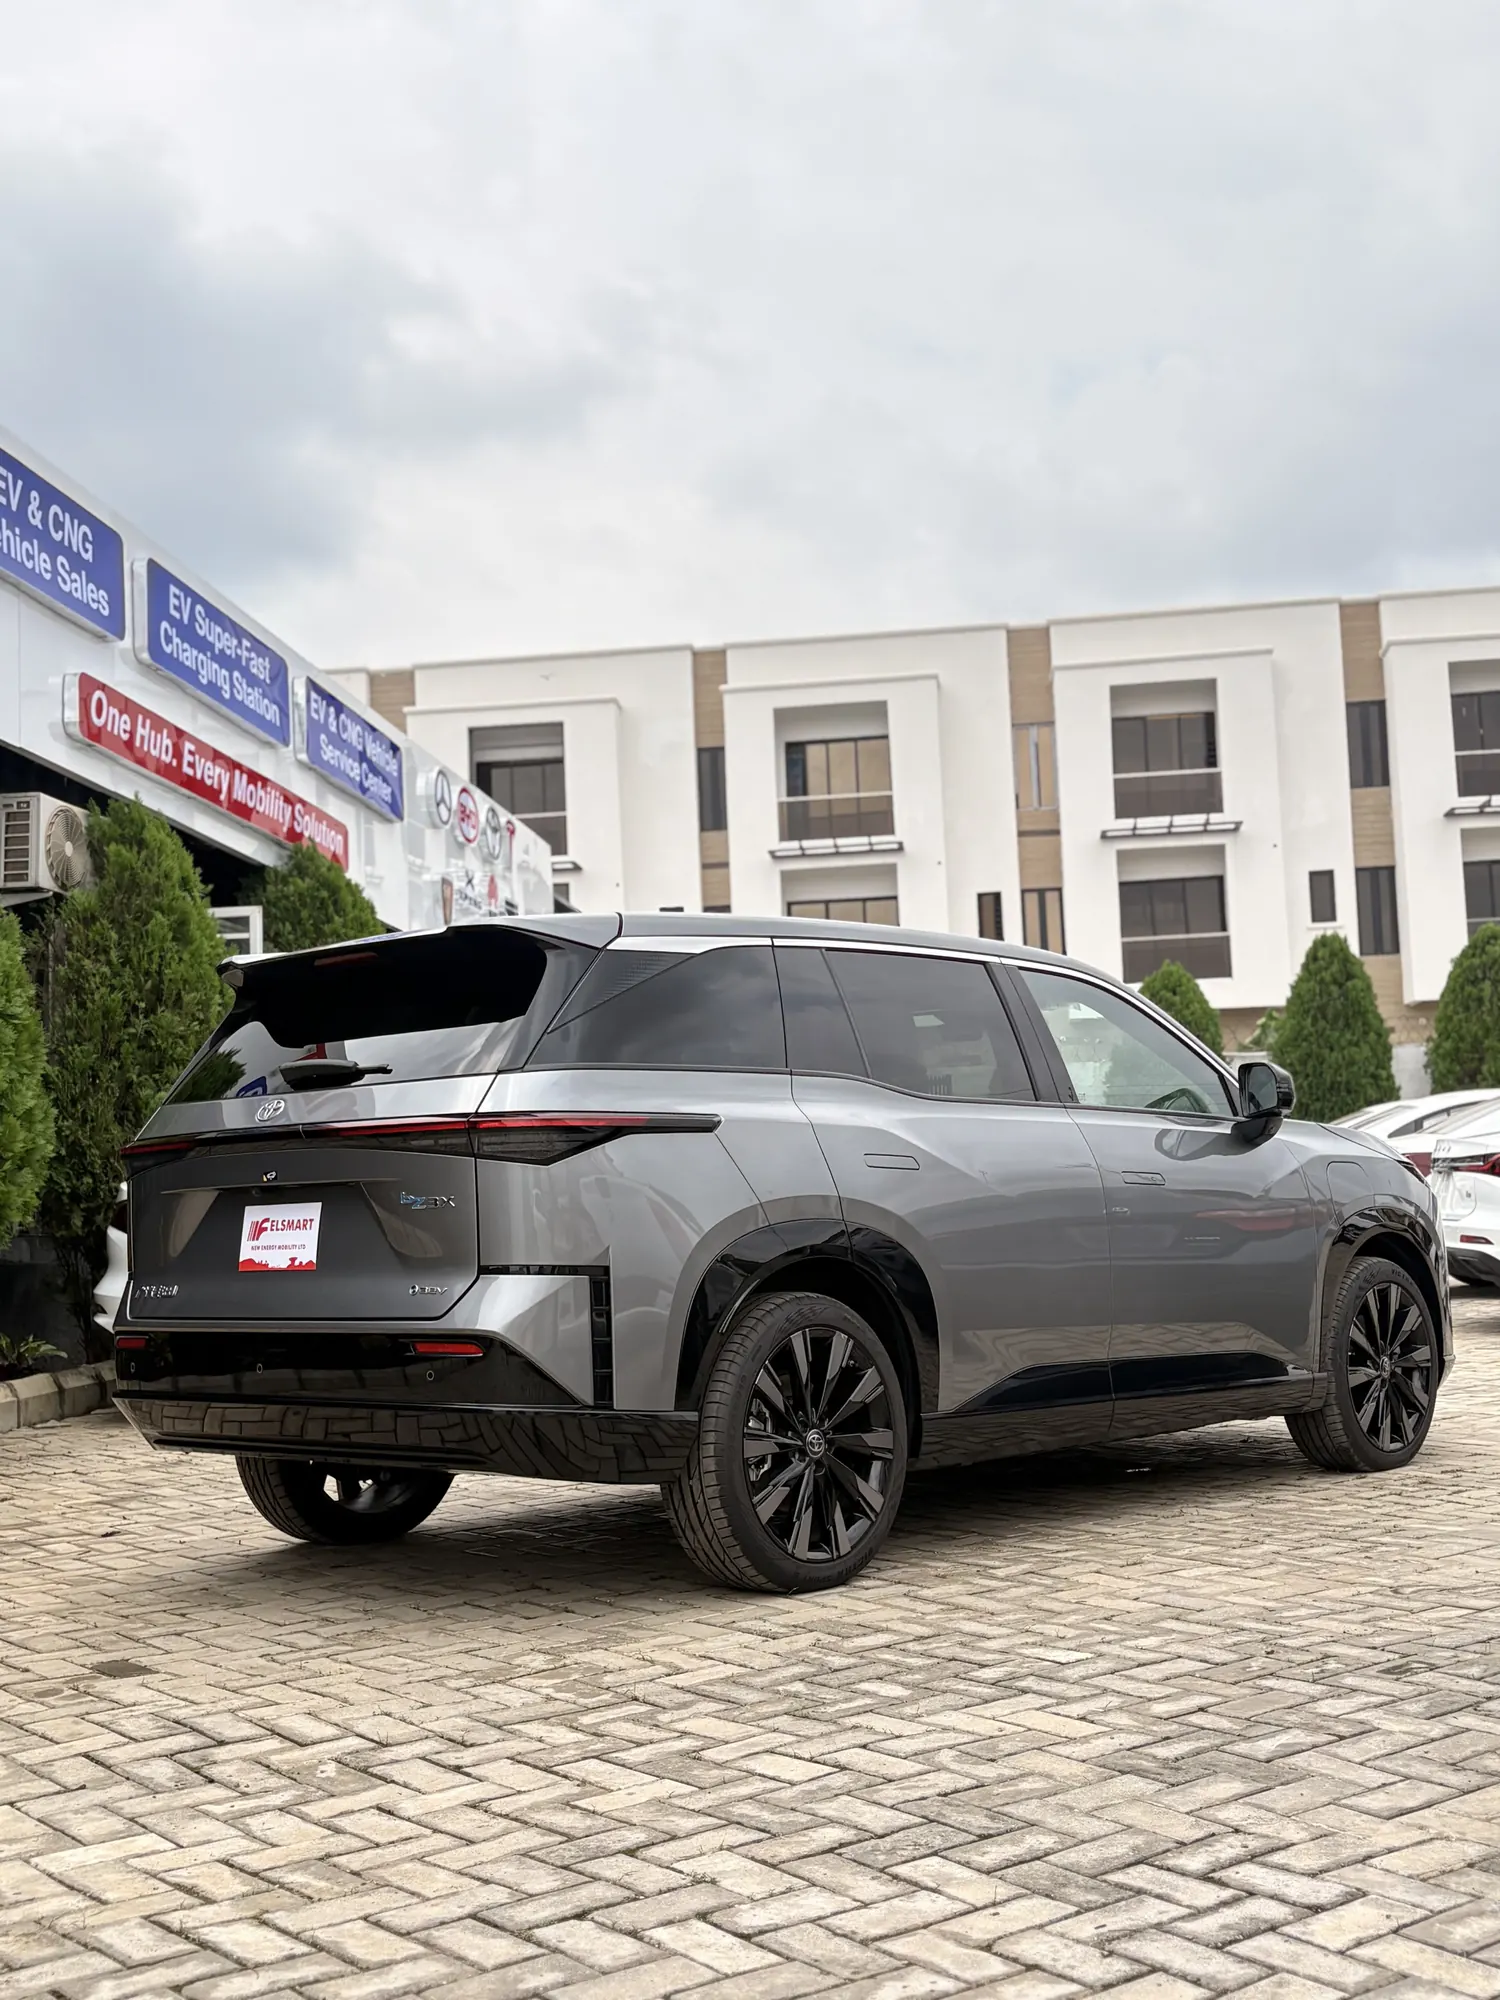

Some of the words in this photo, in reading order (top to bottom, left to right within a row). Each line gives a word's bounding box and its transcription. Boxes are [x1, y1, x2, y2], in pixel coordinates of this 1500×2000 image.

[0, 518, 52, 581] hicle
[57, 555, 110, 616] Sales
[27, 490, 43, 530] &
[48, 504, 93, 563] CNG
[160, 620, 231, 700] Charging
[233, 670, 281, 727] Station
[169, 583, 192, 625] EV
[194, 604, 271, 684] Super-Fast
[90, 689, 131, 741] One
[135, 713, 177, 767] Hub.
[182, 740, 230, 802] Every
[232, 769, 292, 833] Mobility
[293, 803, 344, 856] Solution
[310, 690, 327, 724] EV
[328, 705, 338, 734] &
[339, 713, 363, 752] CNG
[364, 731, 398, 777] Vehicle
[320, 733, 361, 781] Service
[361, 762, 393, 803] Center
[247, 1217, 315, 1241] FELSMART
